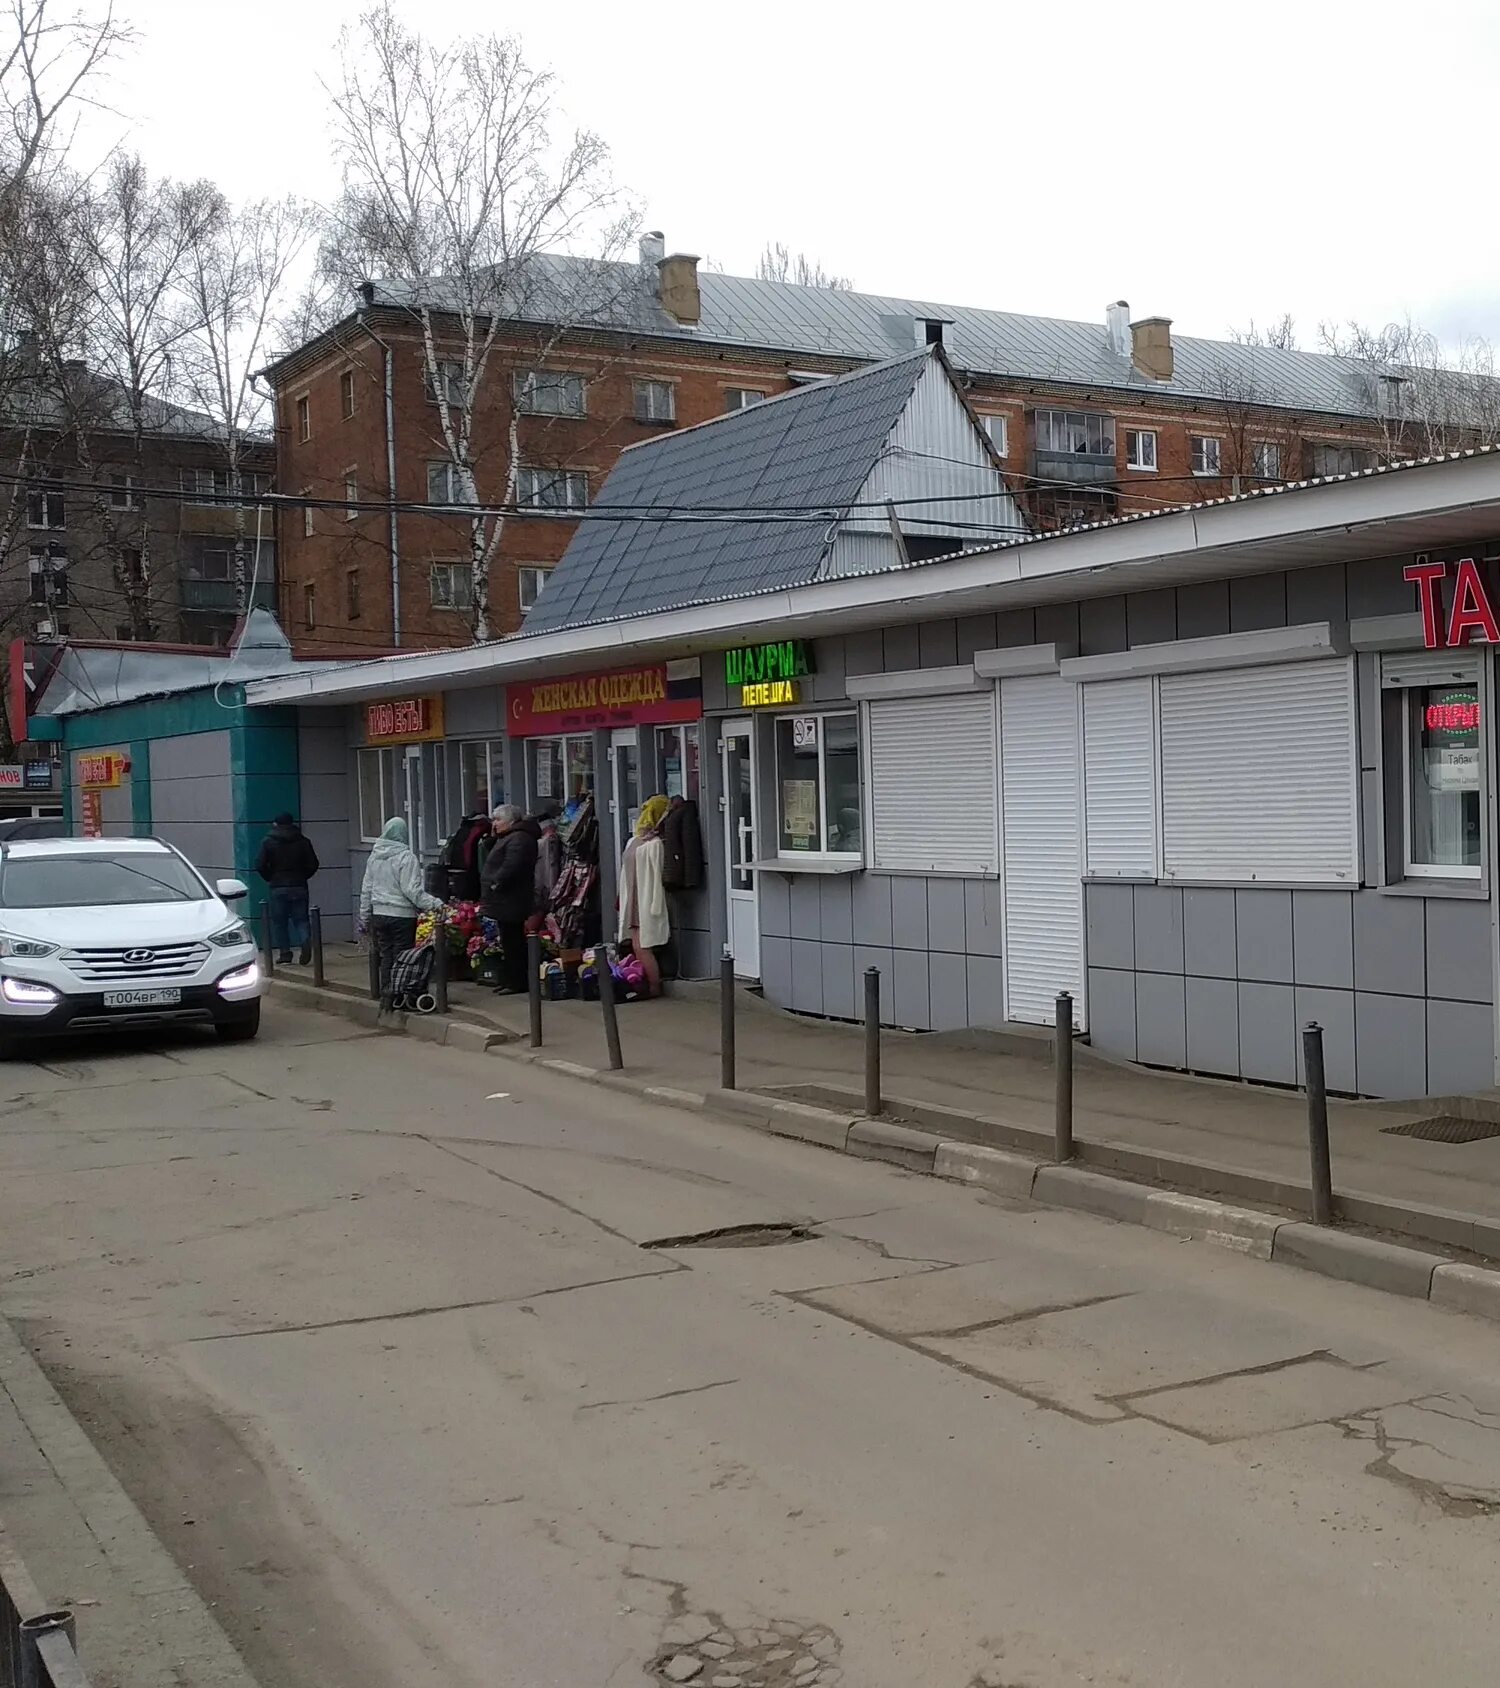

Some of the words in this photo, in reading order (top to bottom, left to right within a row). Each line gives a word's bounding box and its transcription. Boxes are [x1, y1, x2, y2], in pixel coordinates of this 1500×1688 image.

[726, 641, 809, 684] ШАУРМА
[531, 679, 596, 713] ЖЕНСКАЯ
[600, 669, 665, 709] ОДЕЖДА
[742, 680, 793, 706] ЛЕПЕШКА
[368, 704, 393, 735] ПИВО
[1448, 754, 1472, 765] Табак
[160, 989, 178, 998] 190
